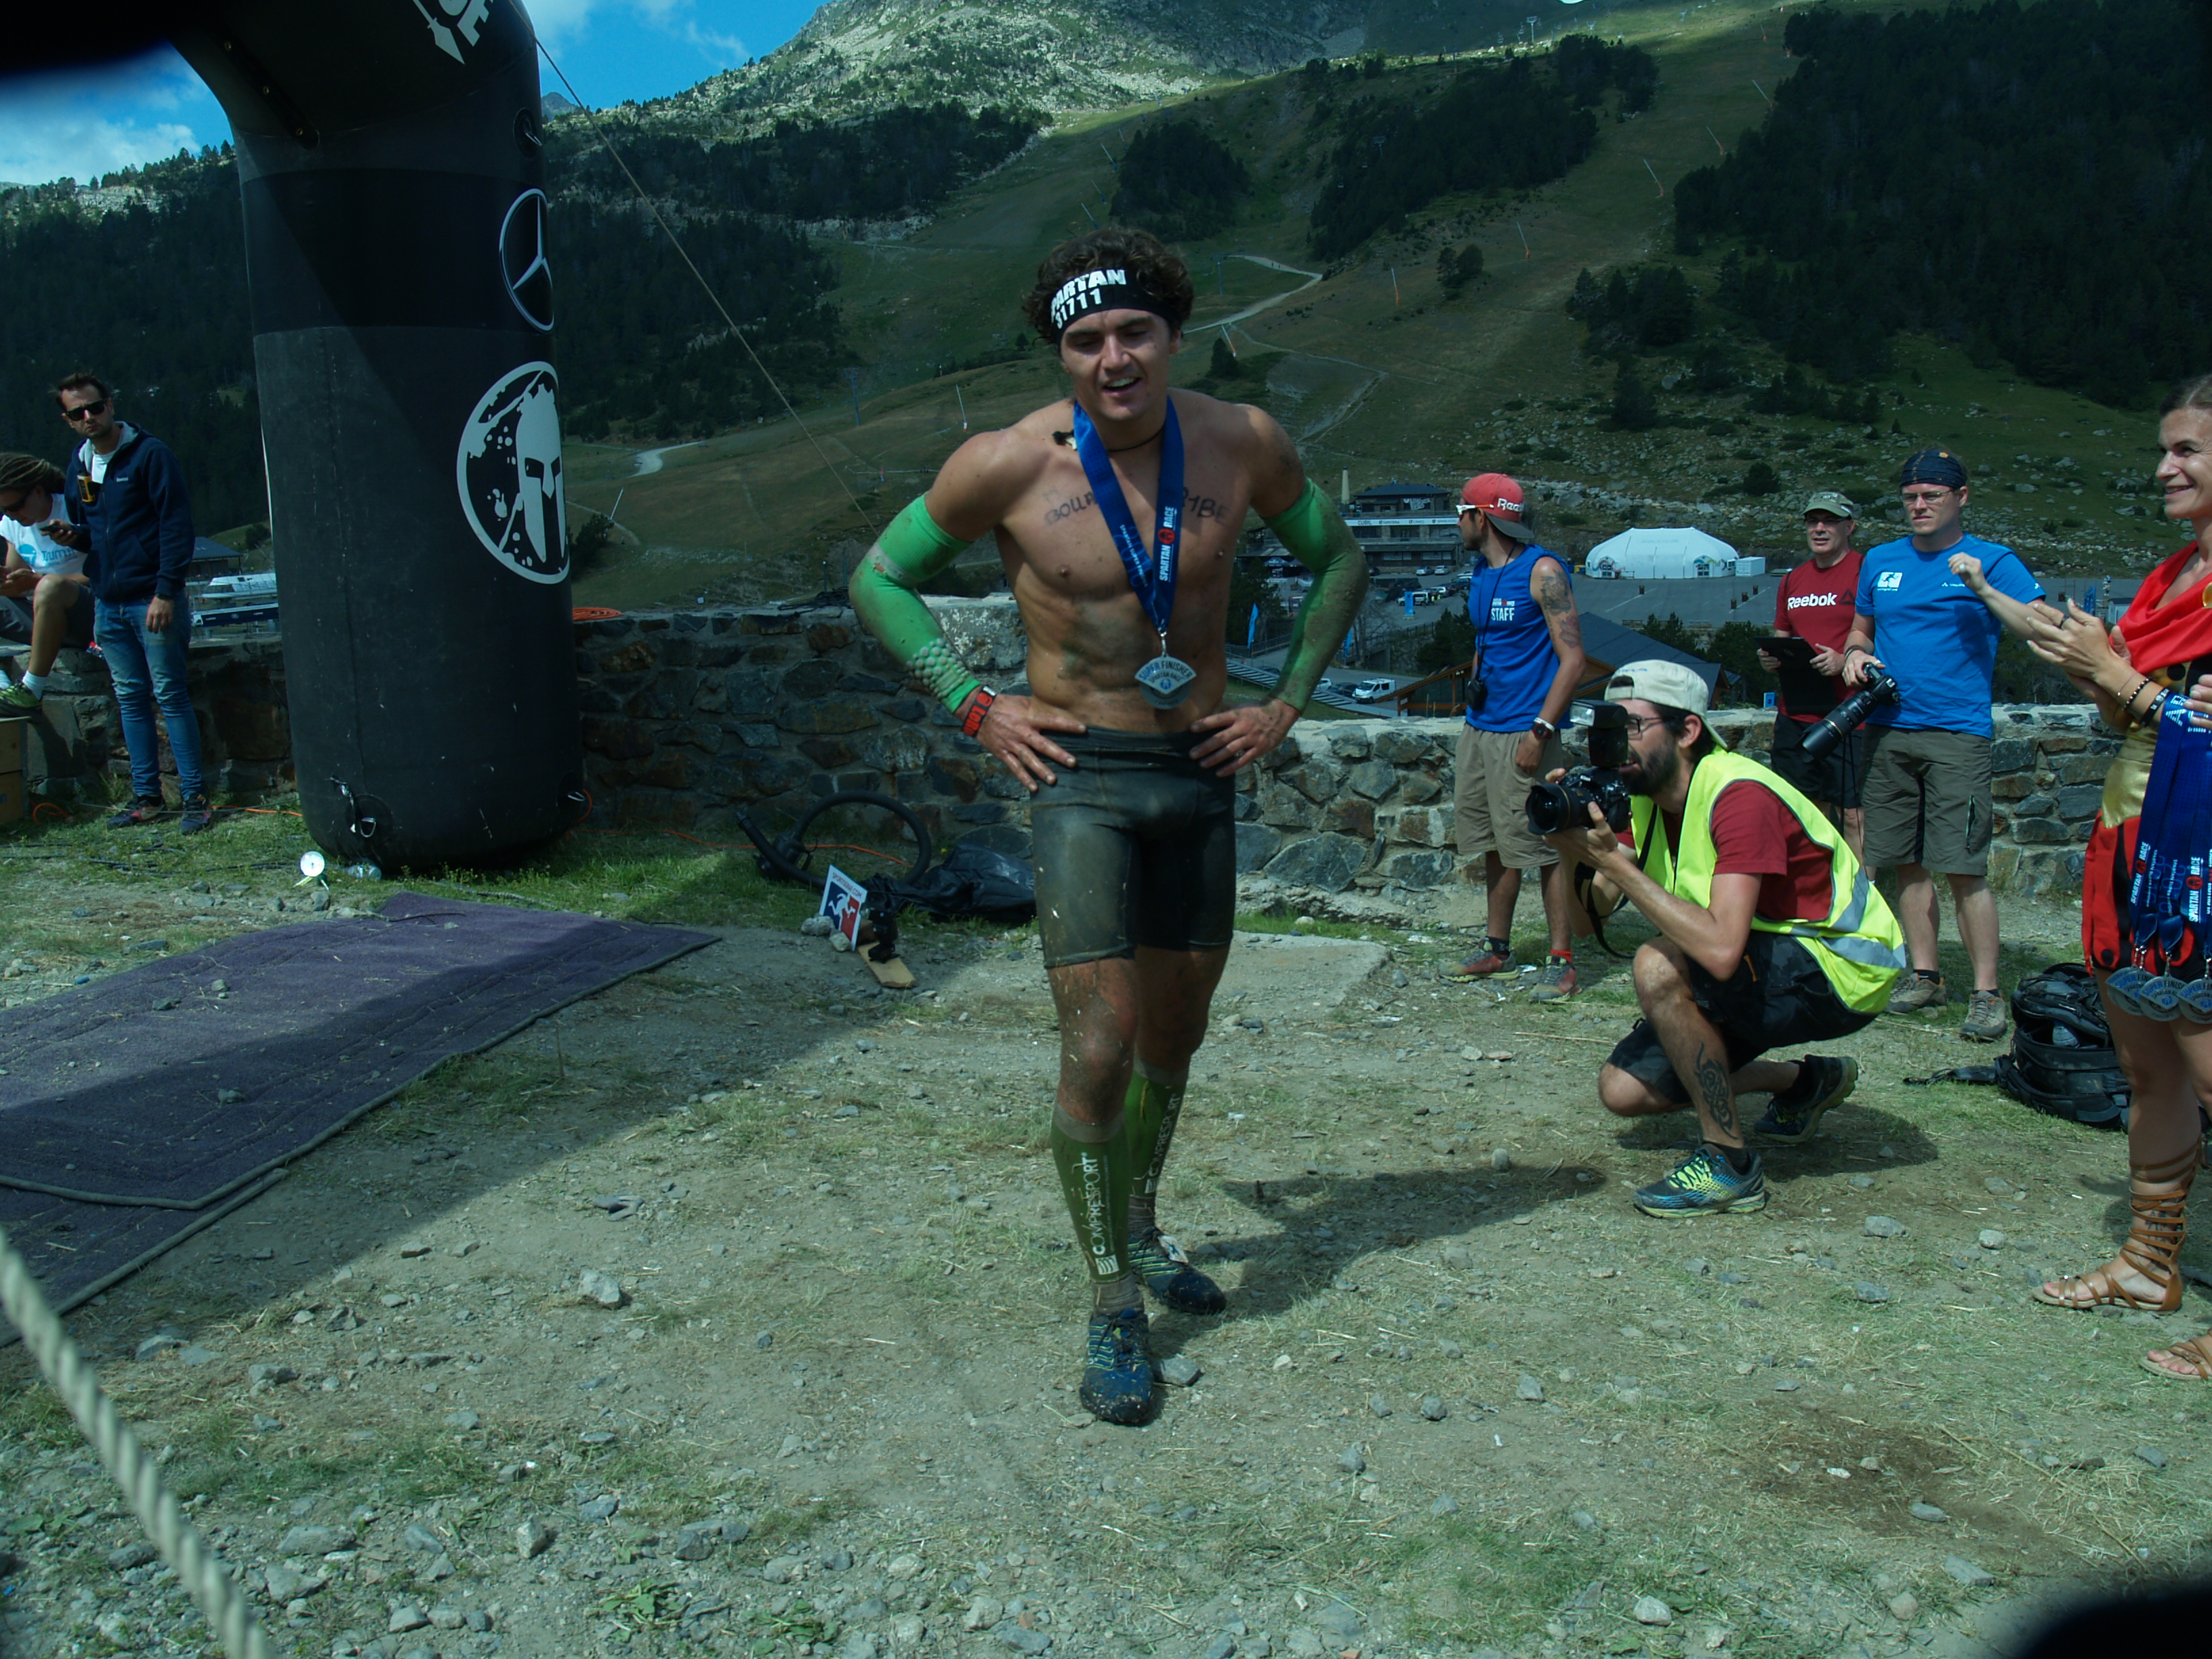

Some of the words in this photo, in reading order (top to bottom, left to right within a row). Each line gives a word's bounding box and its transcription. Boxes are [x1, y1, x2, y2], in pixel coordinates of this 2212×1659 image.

[1051, 269, 1127, 324] PARTAN
[1163, 506, 1174, 528] RACE
[1159, 544, 1171, 581] SPARTAN
[1787, 592, 1837, 611] Reebok
[1491, 607, 1515, 621] STAFF
[1162, 661, 1192, 678] FINISHER
[2130, 873, 2142, 904] SPARTAN
[2139, 841, 2150, 861] RACE
[2190, 857, 2201, 876] RACE
[2188, 890, 2200, 922] SPARTAN
[2142, 981, 2163, 996] SUPER
[2180, 983, 2201, 998] SUPER
